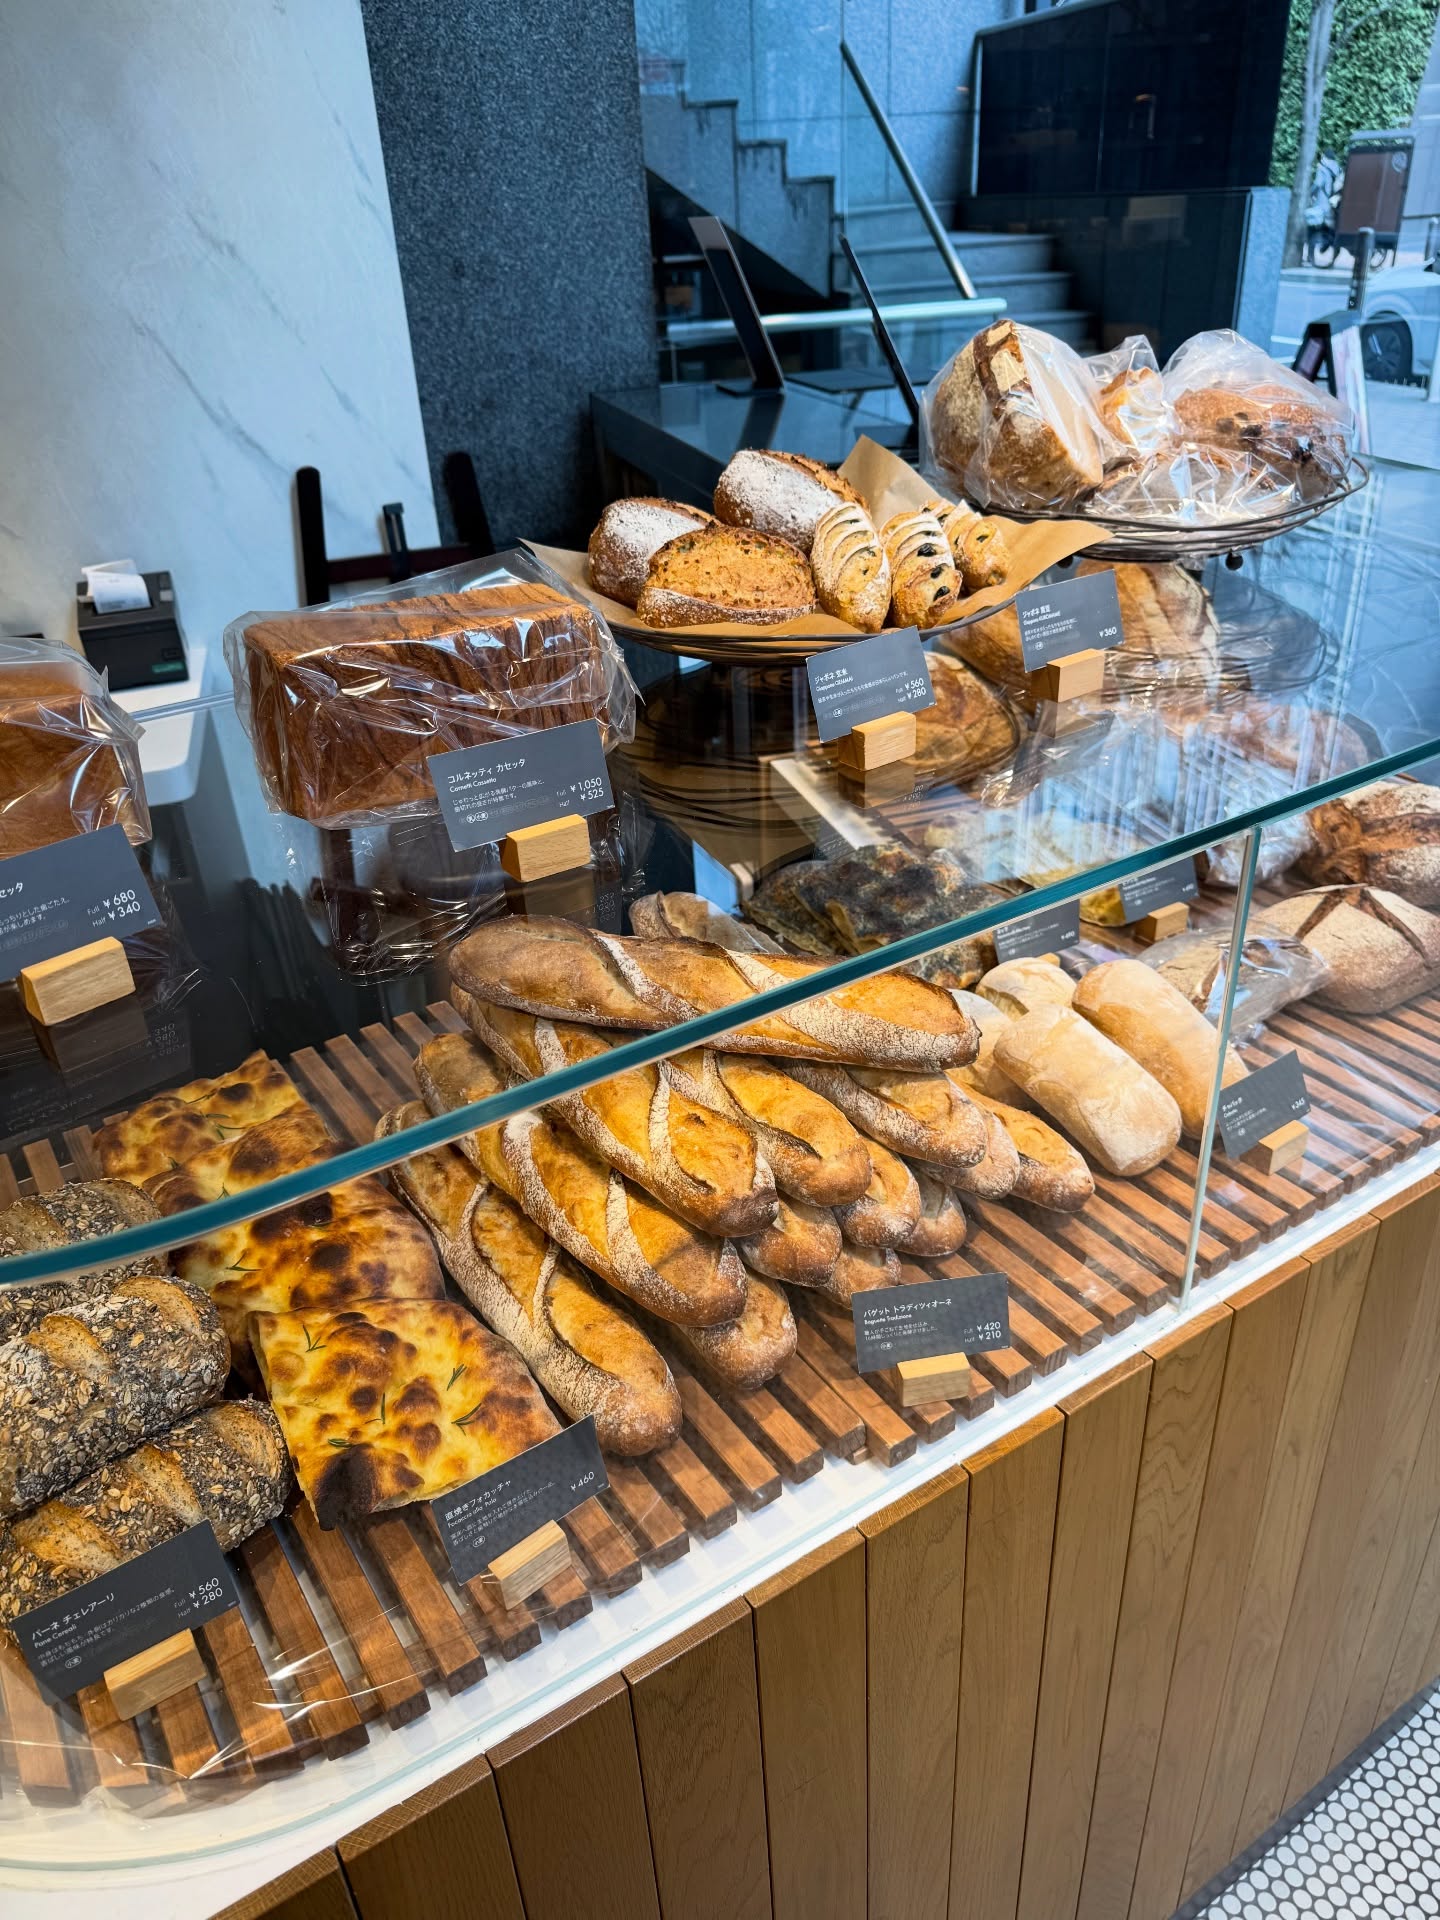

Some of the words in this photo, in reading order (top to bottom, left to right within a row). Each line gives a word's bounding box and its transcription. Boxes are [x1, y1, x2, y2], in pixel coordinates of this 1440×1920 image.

[448, 768, 492, 784] コルネッティ
[496, 759, 526, 773] カセッタ
[864, 1307, 890, 1318] バゲット
[63, 1592, 115, 1625] チェレアーリ
[34, 1637, 52, 1648] Pane
[52, 1624, 77, 1640] Cereali
